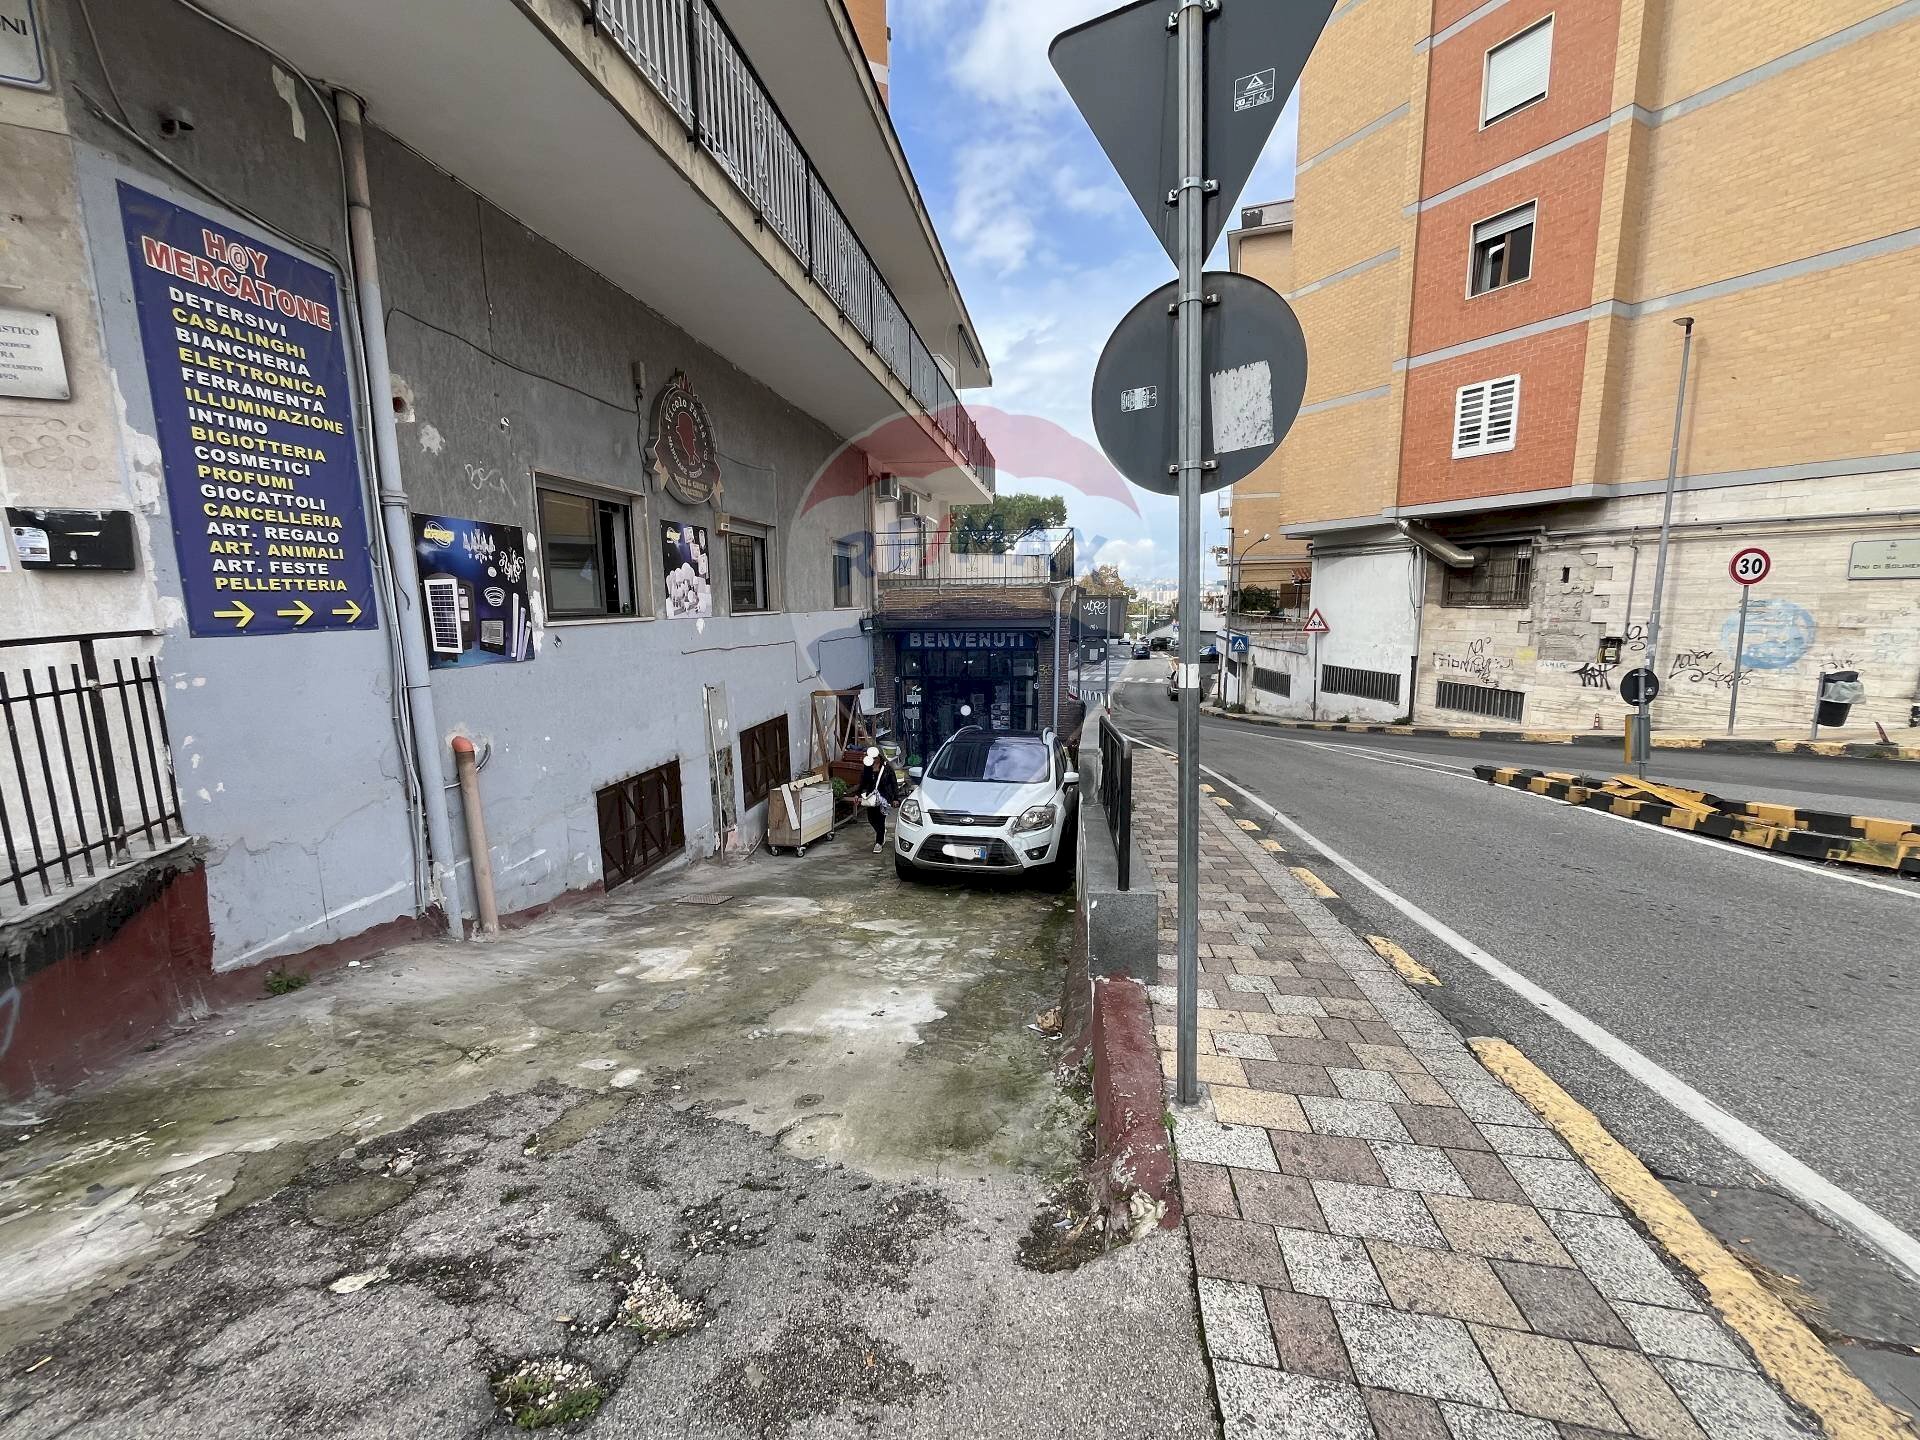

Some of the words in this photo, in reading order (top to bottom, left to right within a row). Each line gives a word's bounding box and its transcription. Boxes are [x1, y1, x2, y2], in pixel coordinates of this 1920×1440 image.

[0, 14, 28, 36] NI
[202, 228, 269, 279] H@Y
[141, 235, 333, 331] MERCATONE
[169, 286, 288, 338] DETERSIVI
[172, 307, 306, 360] CASALINGHI
[175, 327, 311, 378] BIANCHERIA
[178, 347, 327, 398] ELETTRONICA
[181, 367, 325, 415] FERRAMENTA
[184, 387, 345, 435] ILLUMINAZIONE
[188, 406, 269, 436] INTIMO
[191, 426, 327, 463] BIGIOTTERIA
[194, 446, 311, 477] COSMETICI
[197, 464, 295, 491] PROFUMI
[200, 484, 326, 511] GIOCATTOLI
[203, 502, 343, 529] CANCELLERIA
[206, 521, 258, 539] ART.
[264, 526, 340, 544] REGALO
[209, 540, 260, 556] ART.
[267, 545, 345, 561] ANIMALI
[212, 558, 263, 574] ART.
[270, 561, 330, 576] FESTE
[1739, 557, 1763, 575] 30
[215, 577, 348, 592] PELLETTERIA
[909, 632, 1024, 648] BENVENUTI
